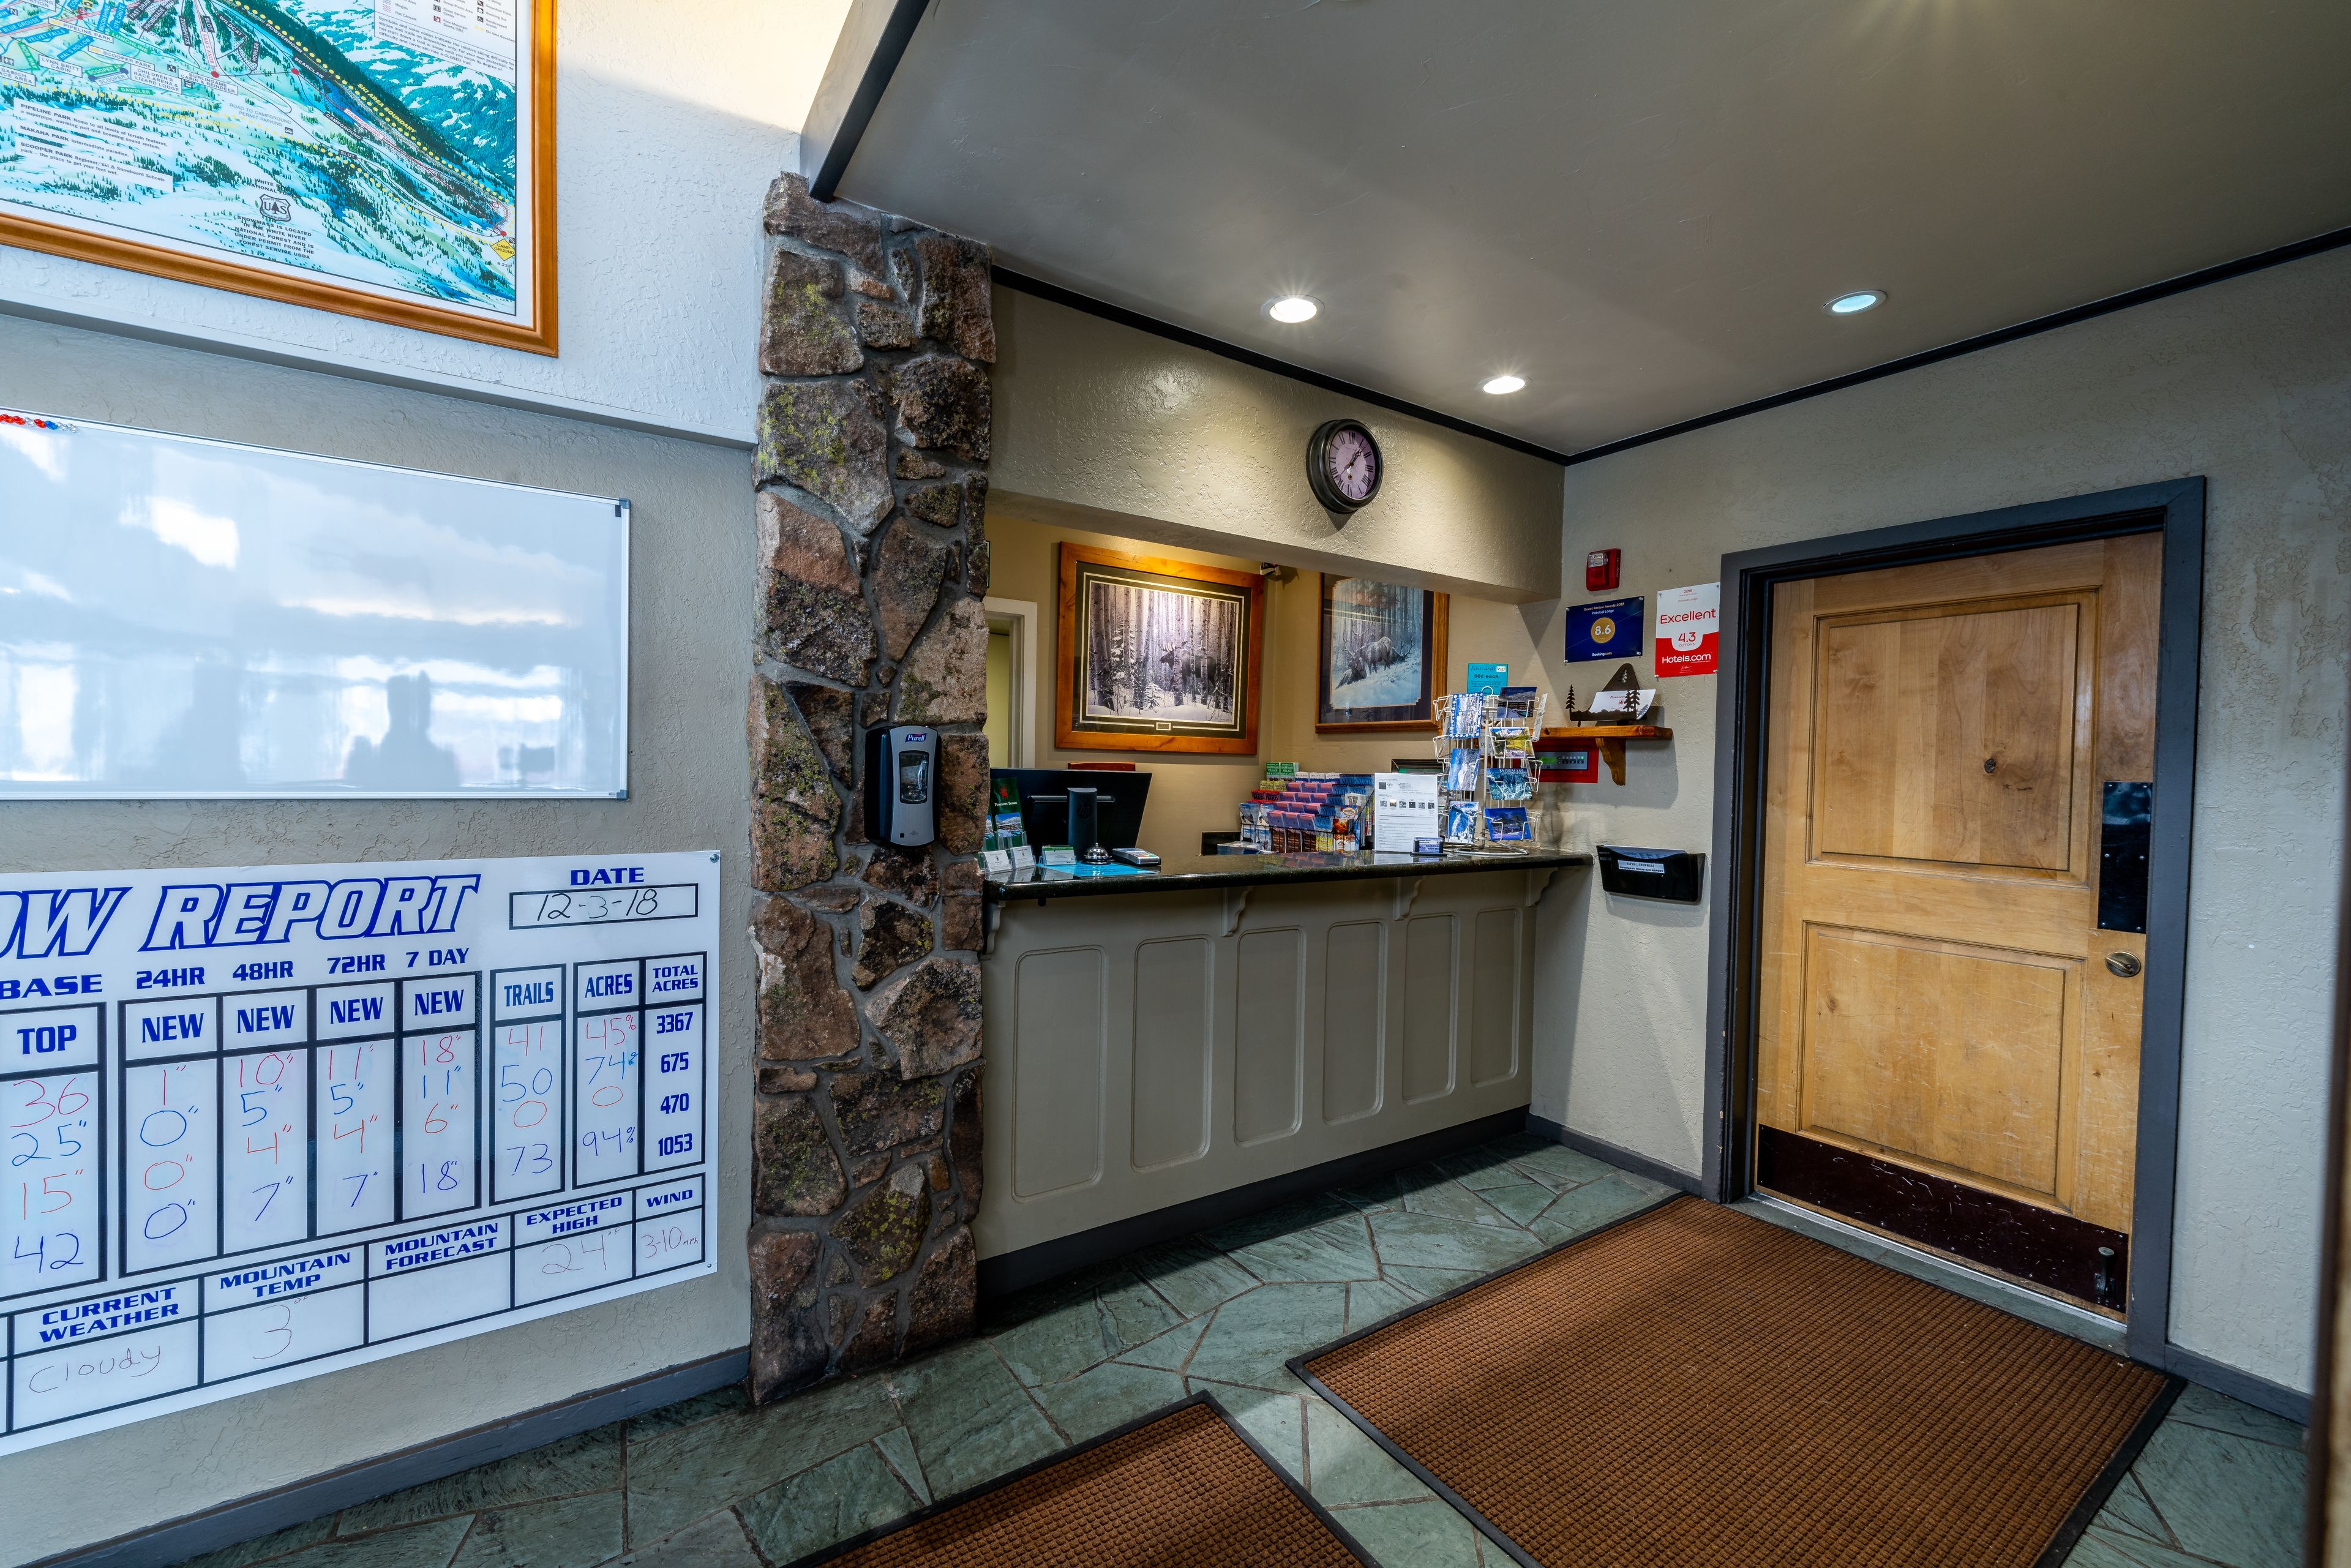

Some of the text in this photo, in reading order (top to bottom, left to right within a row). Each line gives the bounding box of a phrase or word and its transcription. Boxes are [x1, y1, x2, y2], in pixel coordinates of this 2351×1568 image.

[19, 18, 40, 28] GROUSE
[99, 4, 110, 31] MOONSHINE
[144, 7, 165, 31] PROMENADE
[204, 17, 213, 31] SLOT
[219, 15, 243, 36] WILDCAT
[28, 28, 66, 42] VELVET FALLS
[64, 23, 111, 41] PIPELINE PARK
[111, 32, 149, 52] LUNCHLINE
[180, 17, 190, 45] ZUGSPITZE
[266, 23, 302, 53] POWDERHORN
[73, 37, 91, 50] HOLLOW
[61, 63, 80, 72] BRITT
[103, 51, 133, 63] SCOOPER
[294, 57, 324, 78] BEARCLAW
[51, 64, 72, 73] CABIN
[99, 74, 126, 84] SCOOPER
[133, 71, 151, 80] RACE
[152, 77, 173, 86] ARENA
[137, 68, 173, 82] CHILDREN'S
[135, 76, 179, 92] LIZARD LODGE
[181, 75, 200, 83] CABIN
[206, 81, 235, 94] REINDEER
[189, 73, 227, 87] BURLINGAME
[20, 103, 72, 121] PIPELINE PARK
[239, 111, 283, 127] PERMIT PARKING
[255, 111, 291, 124] CAMPGROUND
[358, 83, 416, 133] SKI AREA BOUNDARY
[20, 126, 49, 136] MAKAHA
[326, 114, 361, 140] CAMPGROUND
[347, 111, 381, 137] CAMPGROUND
[21, 142, 53, 154] SCOOPER
[1660, 608, 1716, 625] Excellent
[1595, 625, 1611, 636] 8.6
[1678, 632, 1696, 643] 4.3
[1662, 653, 1711, 664] Hotels.com
[570, 867, 645, 887] DATE
[138, 874, 481, 952] REPORT
[536, 889, 659, 921] 12-3-18
[327, 954, 386, 975] 72HR
[406, 948, 469, 968] 7 DAY
[137, 967, 205, 989] 24HR
[233, 961, 293, 981] 48HR
[652, 964, 698, 980] TOTAL
[0, 974, 102, 1000] BASE
[504, 981, 553, 1007] TRAILS
[584, 973, 632, 999] ACRES
[652, 977, 698, 992] ACRES
[330, 997, 384, 1024] NEW
[414, 989, 464, 1016] NEW
[142, 1013, 204, 1043] NEW
[238, 1005, 294, 1033] NEW
[656, 1011, 694, 1034] 3367
[17, 1025, 77, 1055] TOP
[506, 1023, 543, 1056] 41
[584, 1014, 636, 1049] 45%
[661, 1051, 689, 1073] 675
[501, 1065, 552, 1103] 50
[593, 1086, 623, 1106] 0
[661, 1093, 689, 1114] 470
[512, 1099, 547, 1127] 0
[583, 1125, 638, 1158] 94%
[658, 1133, 692, 1157] 1053
[507, 1144, 552, 1176] 73
[647, 1190, 694, 1210] WIND
[525, 1196, 624, 1227] EXPECTED
[552, 1214, 599, 1236] HIGH
[384, 1221, 500, 1258] MOUNTAIN
[14, 1233, 84, 1273] 42
[385, 1236, 498, 1272] FORECAST
[219, 1251, 352, 1291] MOUNTAIN
[251, 1273, 322, 1299] TEMP
[41, 1287, 178, 1327] CURRENT
[38, 1302, 180, 1345] WEATHER
